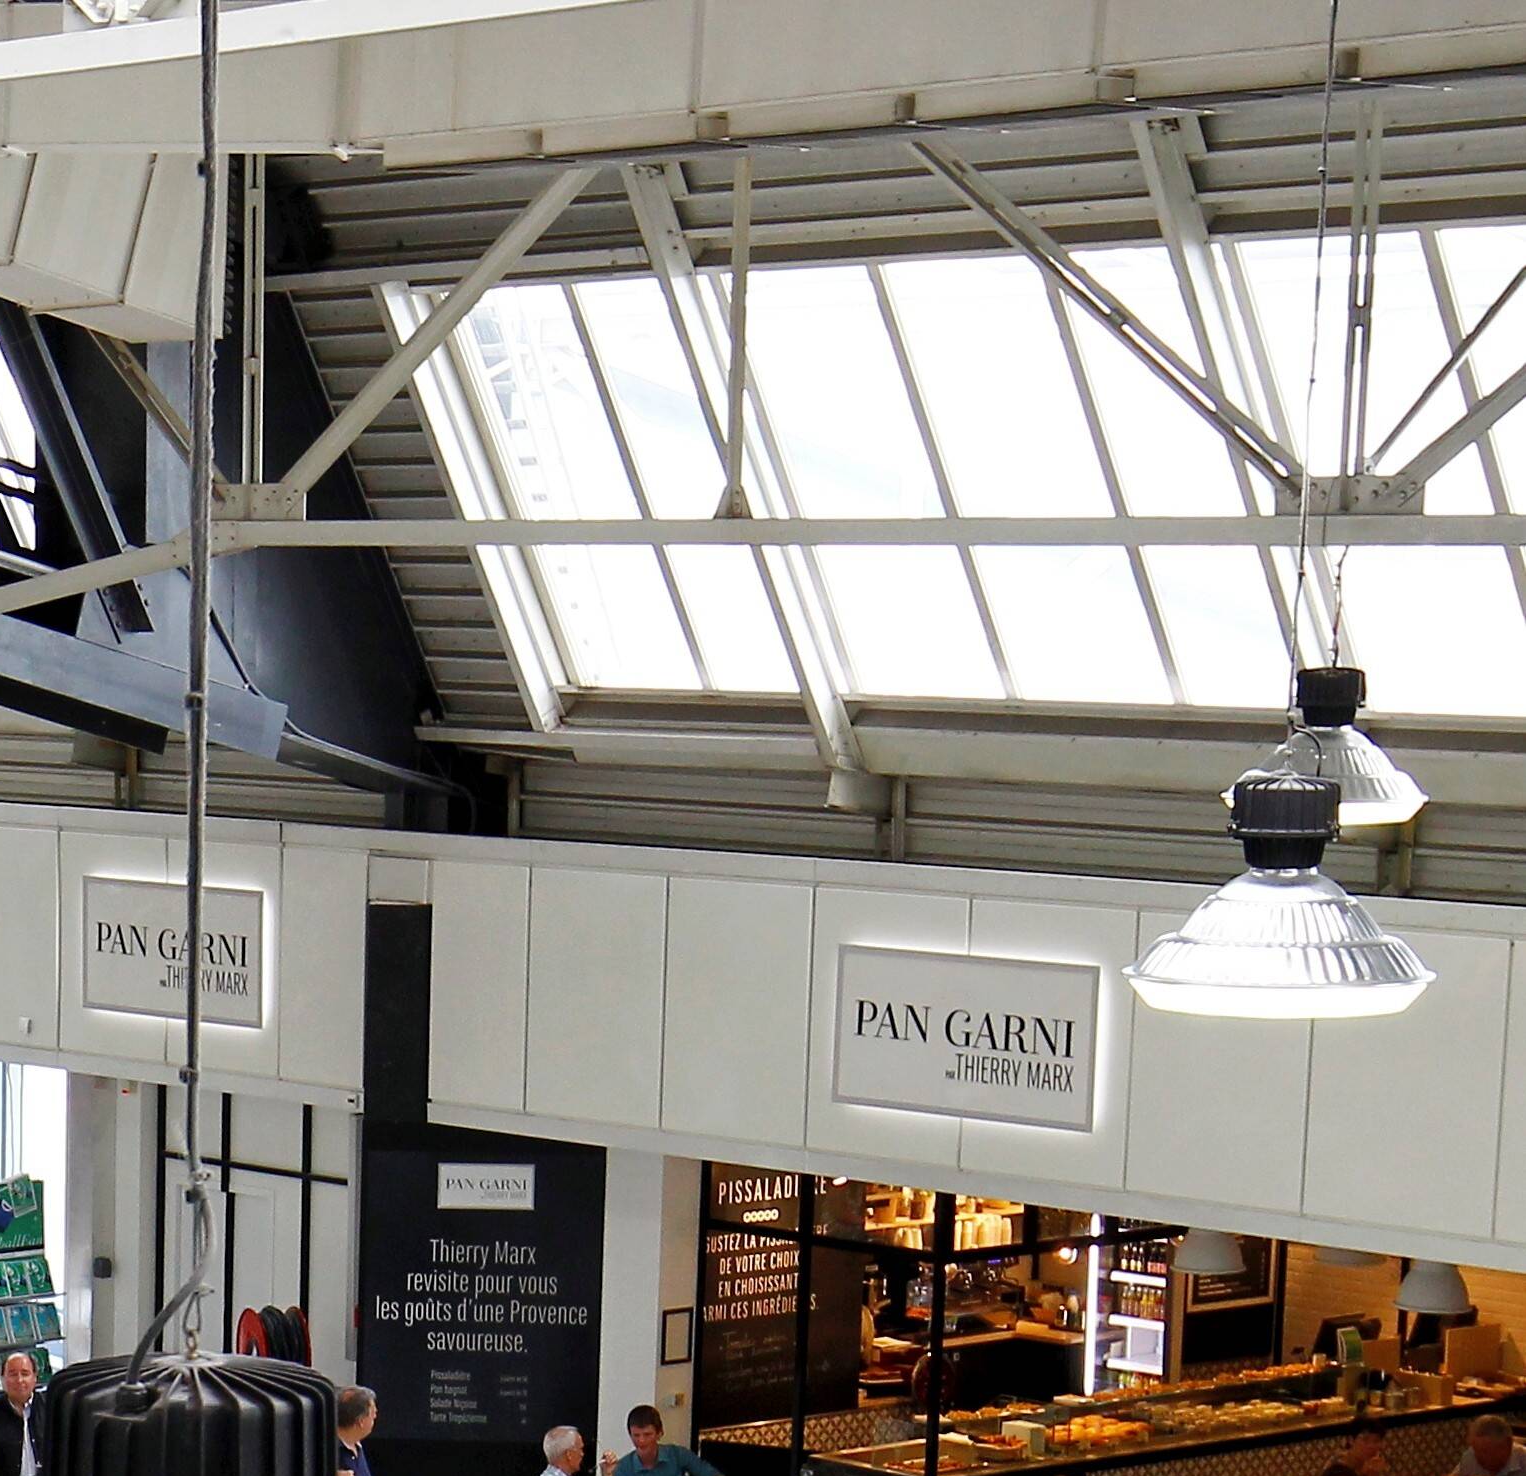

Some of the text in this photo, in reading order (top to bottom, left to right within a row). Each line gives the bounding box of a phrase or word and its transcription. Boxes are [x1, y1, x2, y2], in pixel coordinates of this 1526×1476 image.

[97, 921, 147, 958] PAN
[216, 971, 248, 997] MARX
[854, 999, 1075, 1058] PAN GARNI
[955, 1053, 1022, 1087] THIERRY
[1027, 1061, 1074, 1093] MARX
[446, 1178, 527, 1190] PAN GARNI
[430, 1239, 537, 1270] Thierry Marx
[719, 1250, 800, 1275] DE VOTRE CHOIX
[406, 1269, 558, 1299] revisite pour vous
[718, 1272, 798, 1298] EN CHOISISSANT
[376, 1295, 588, 1327] les goûts d'une Provence
[730, 1301, 748, 1320] CES
[427, 1331, 528, 1353] savoureuse.
